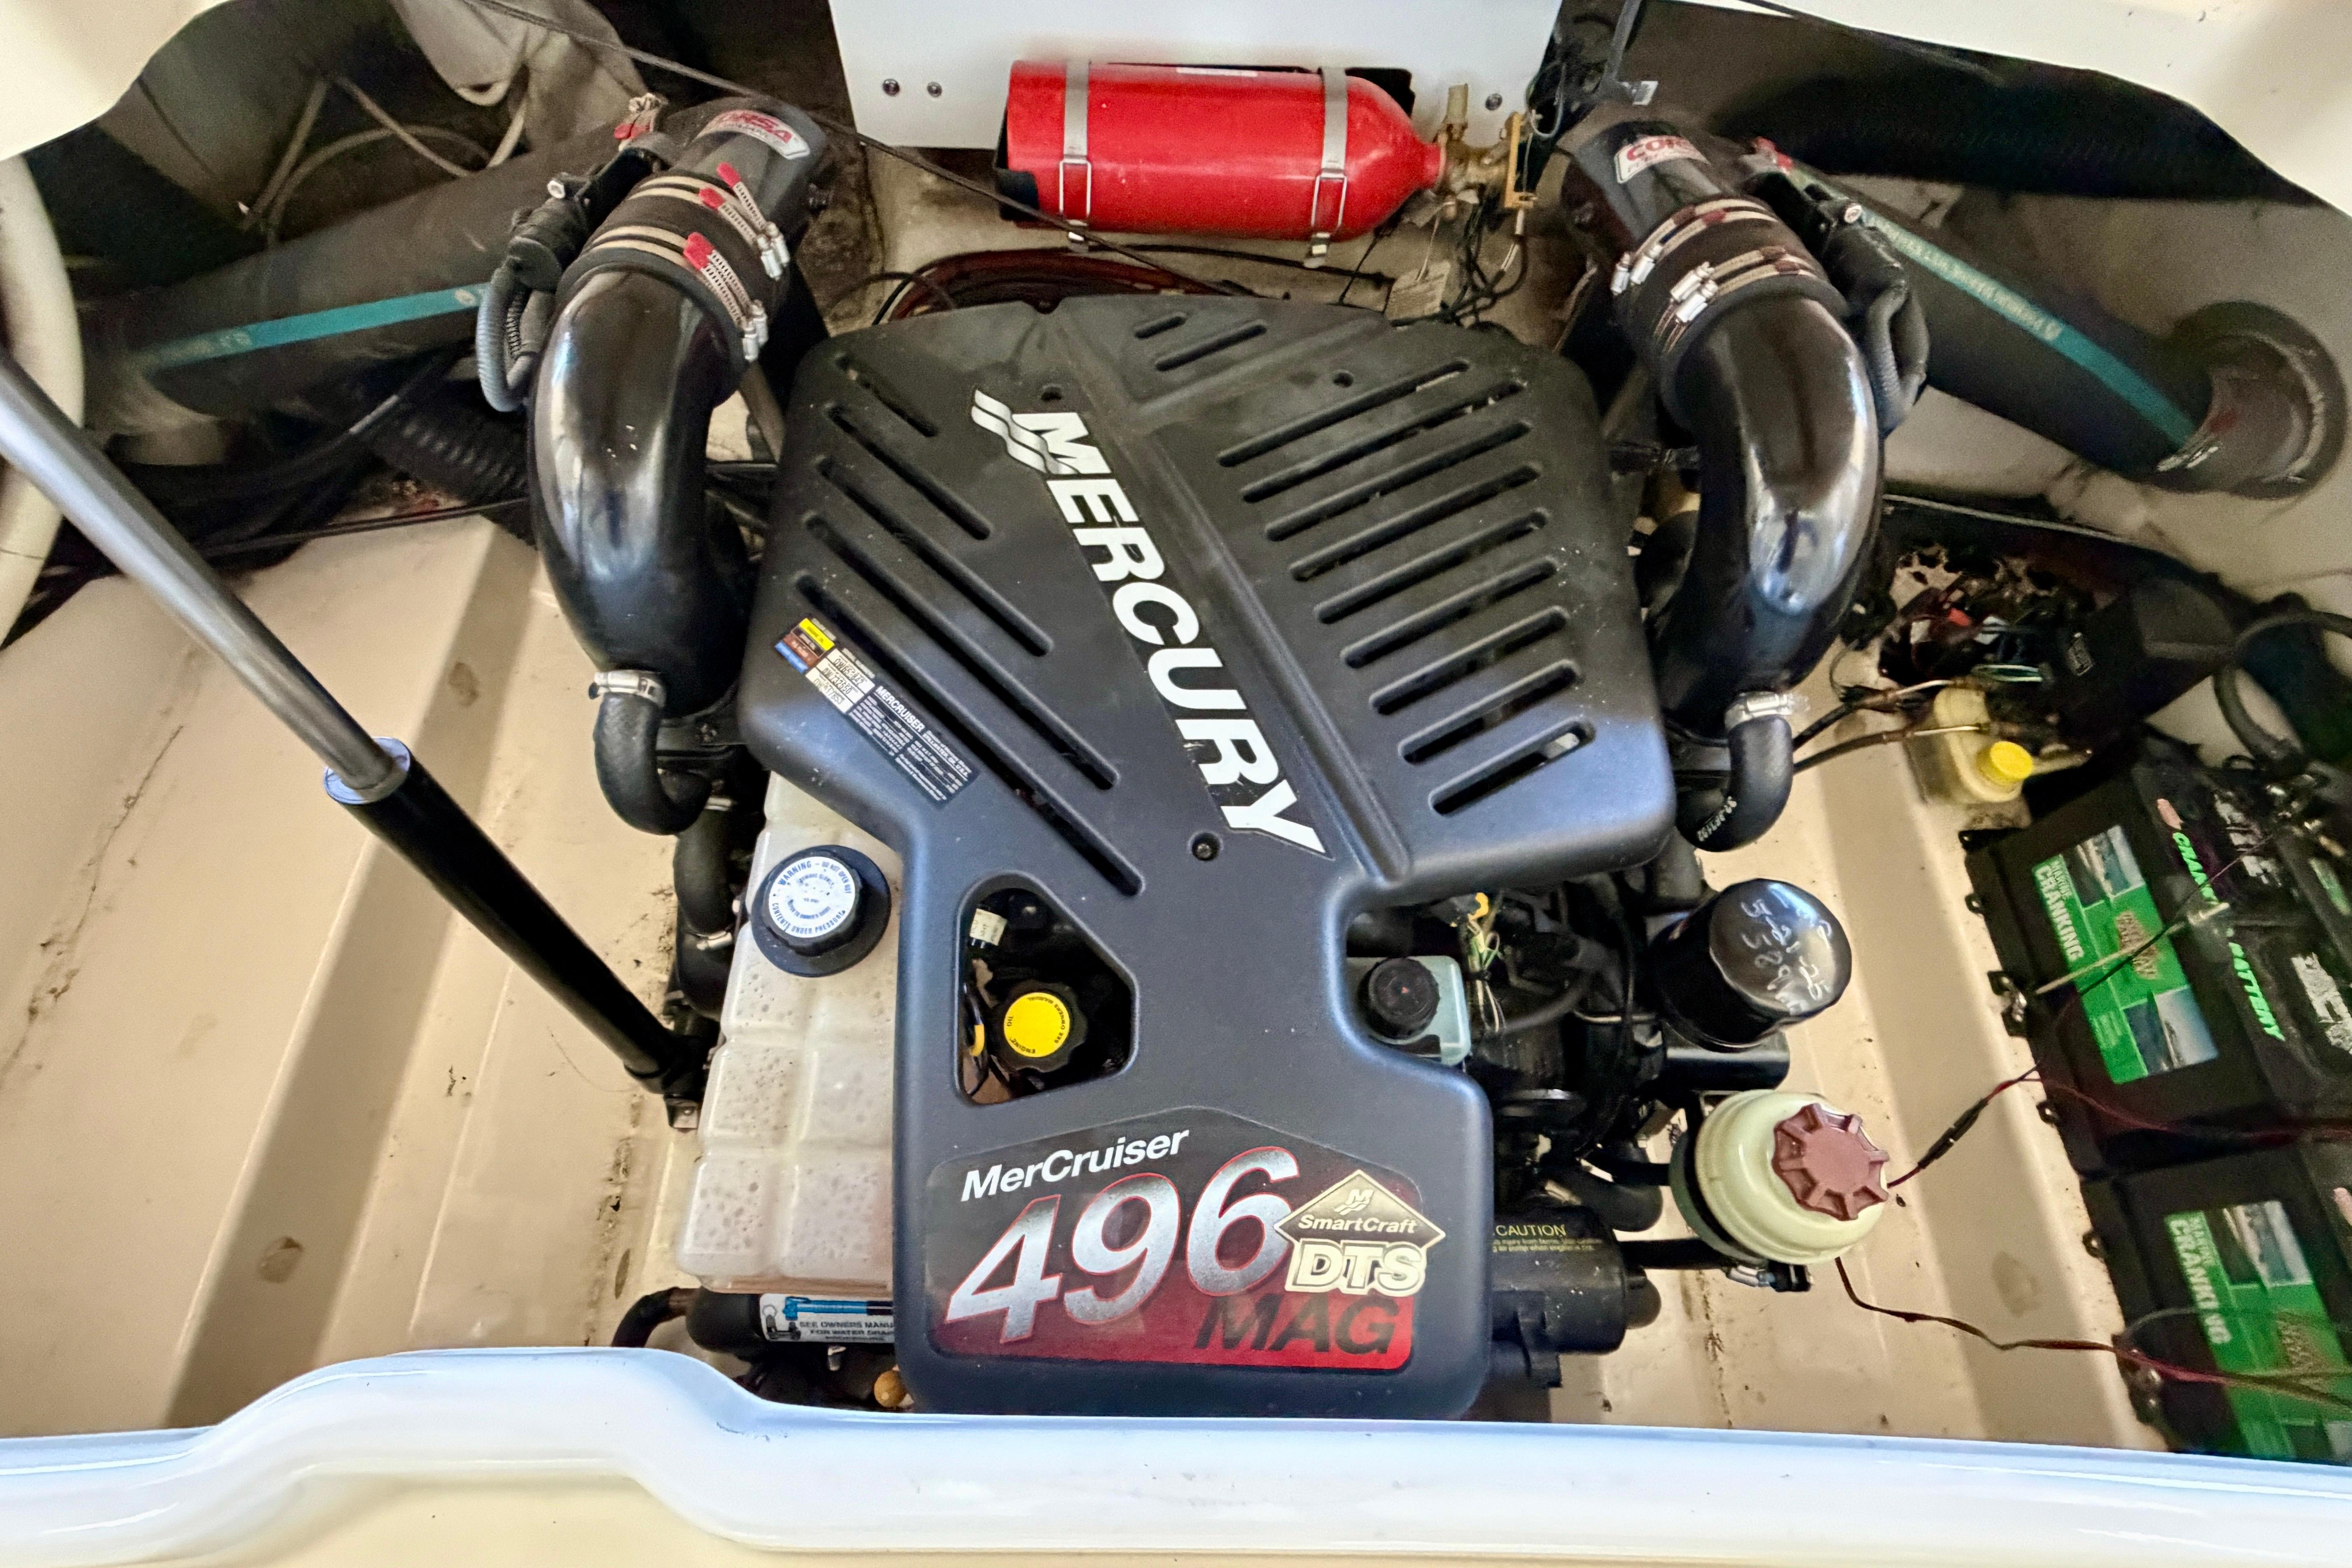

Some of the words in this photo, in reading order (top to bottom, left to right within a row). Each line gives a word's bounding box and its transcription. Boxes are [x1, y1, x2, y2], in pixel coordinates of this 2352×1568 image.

[719, 111, 793, 144] RSA
[1011, 412, 1326, 853] MERCURY
[875, 686, 926, 733] MERCRUISER
[778, 861, 812, 885] WARNING
[791, 926, 812, 934] UNDER
[2033, 865, 2084, 962] CRANKING
[1054, 1004, 1065, 1030] OWNERS
[1010, 1037, 1036, 1053] ENGINE
[1054, 1032, 1064, 1043] SEE
[960, 1129, 1189, 1201] MerCruiser
[1298, 1215, 1419, 1234] SmartCraft
[1496, 1224, 1566, 1236] CAUTION
[945, 1146, 1300, 1344] 496
[1295, 1239, 1424, 1292] DTS
[1194, 1293, 1400, 1354] MAG
